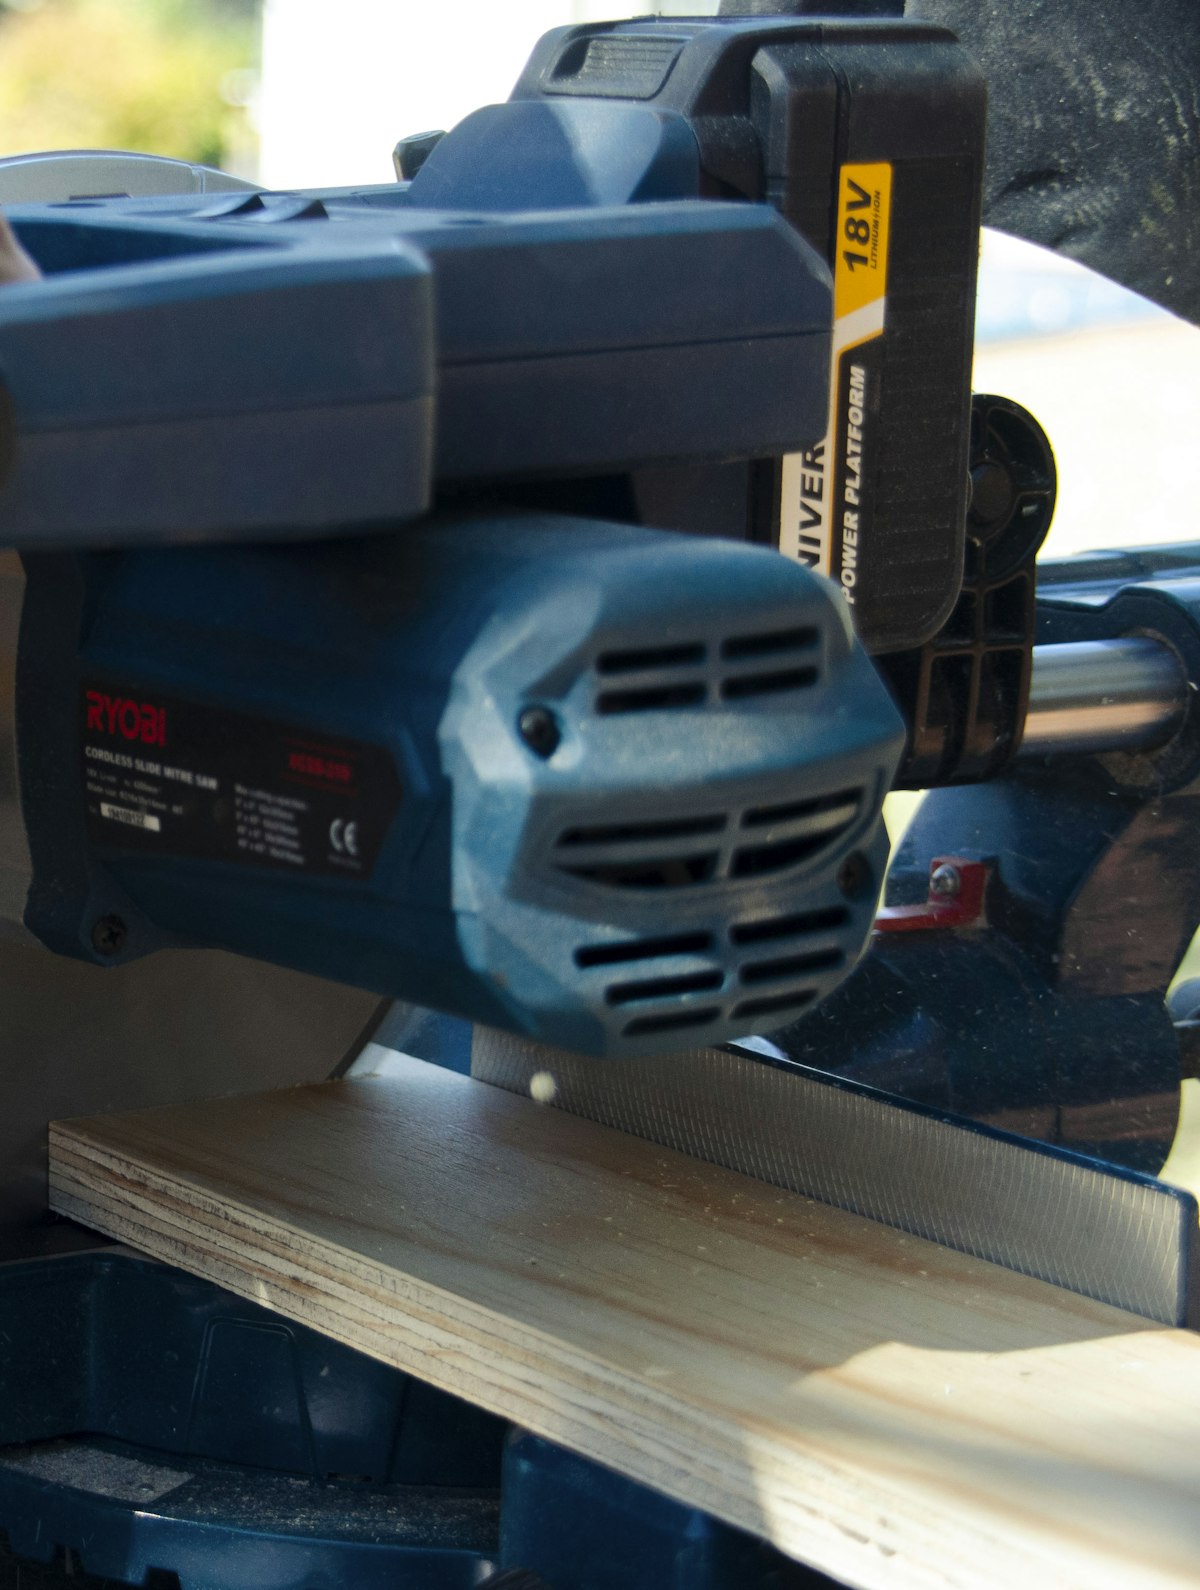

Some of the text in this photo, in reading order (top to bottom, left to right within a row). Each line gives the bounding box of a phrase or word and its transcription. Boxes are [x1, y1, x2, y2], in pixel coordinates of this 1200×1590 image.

[842, 178, 872, 273] 18V
[870, 218, 880, 270] LITHIUM
[798, 445, 825, 569] NIVER
[841, 366, 865, 604] POWER PLATFORM
[86, 690, 167, 746] RYOBI
[85, 745, 133, 768] CORDLESS
[134, 758, 162, 777] SLIDE
[195, 773, 219, 790] SAW
